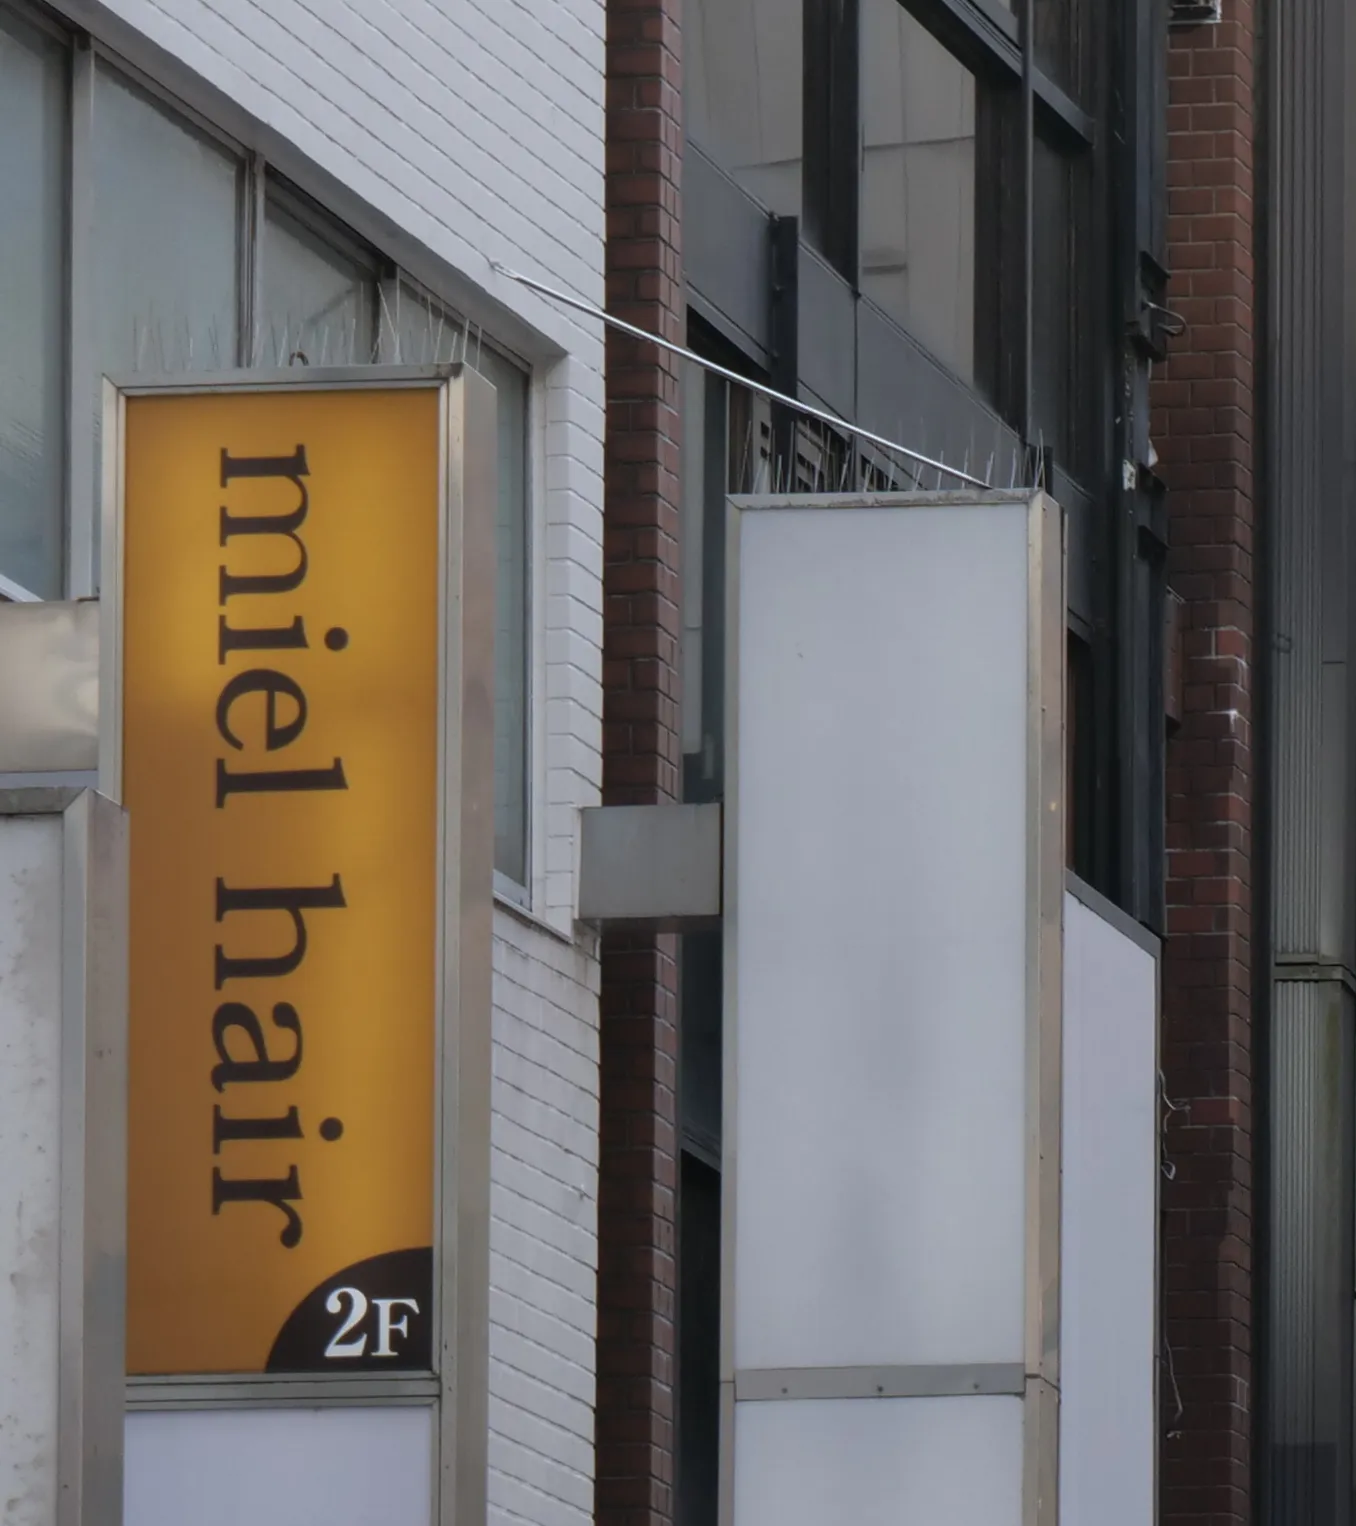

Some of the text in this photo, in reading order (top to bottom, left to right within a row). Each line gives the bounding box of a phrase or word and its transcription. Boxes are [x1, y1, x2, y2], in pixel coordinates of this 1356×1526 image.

[209, 443, 349, 1250] miel hair
[323, 1285, 420, 1359] 2F
